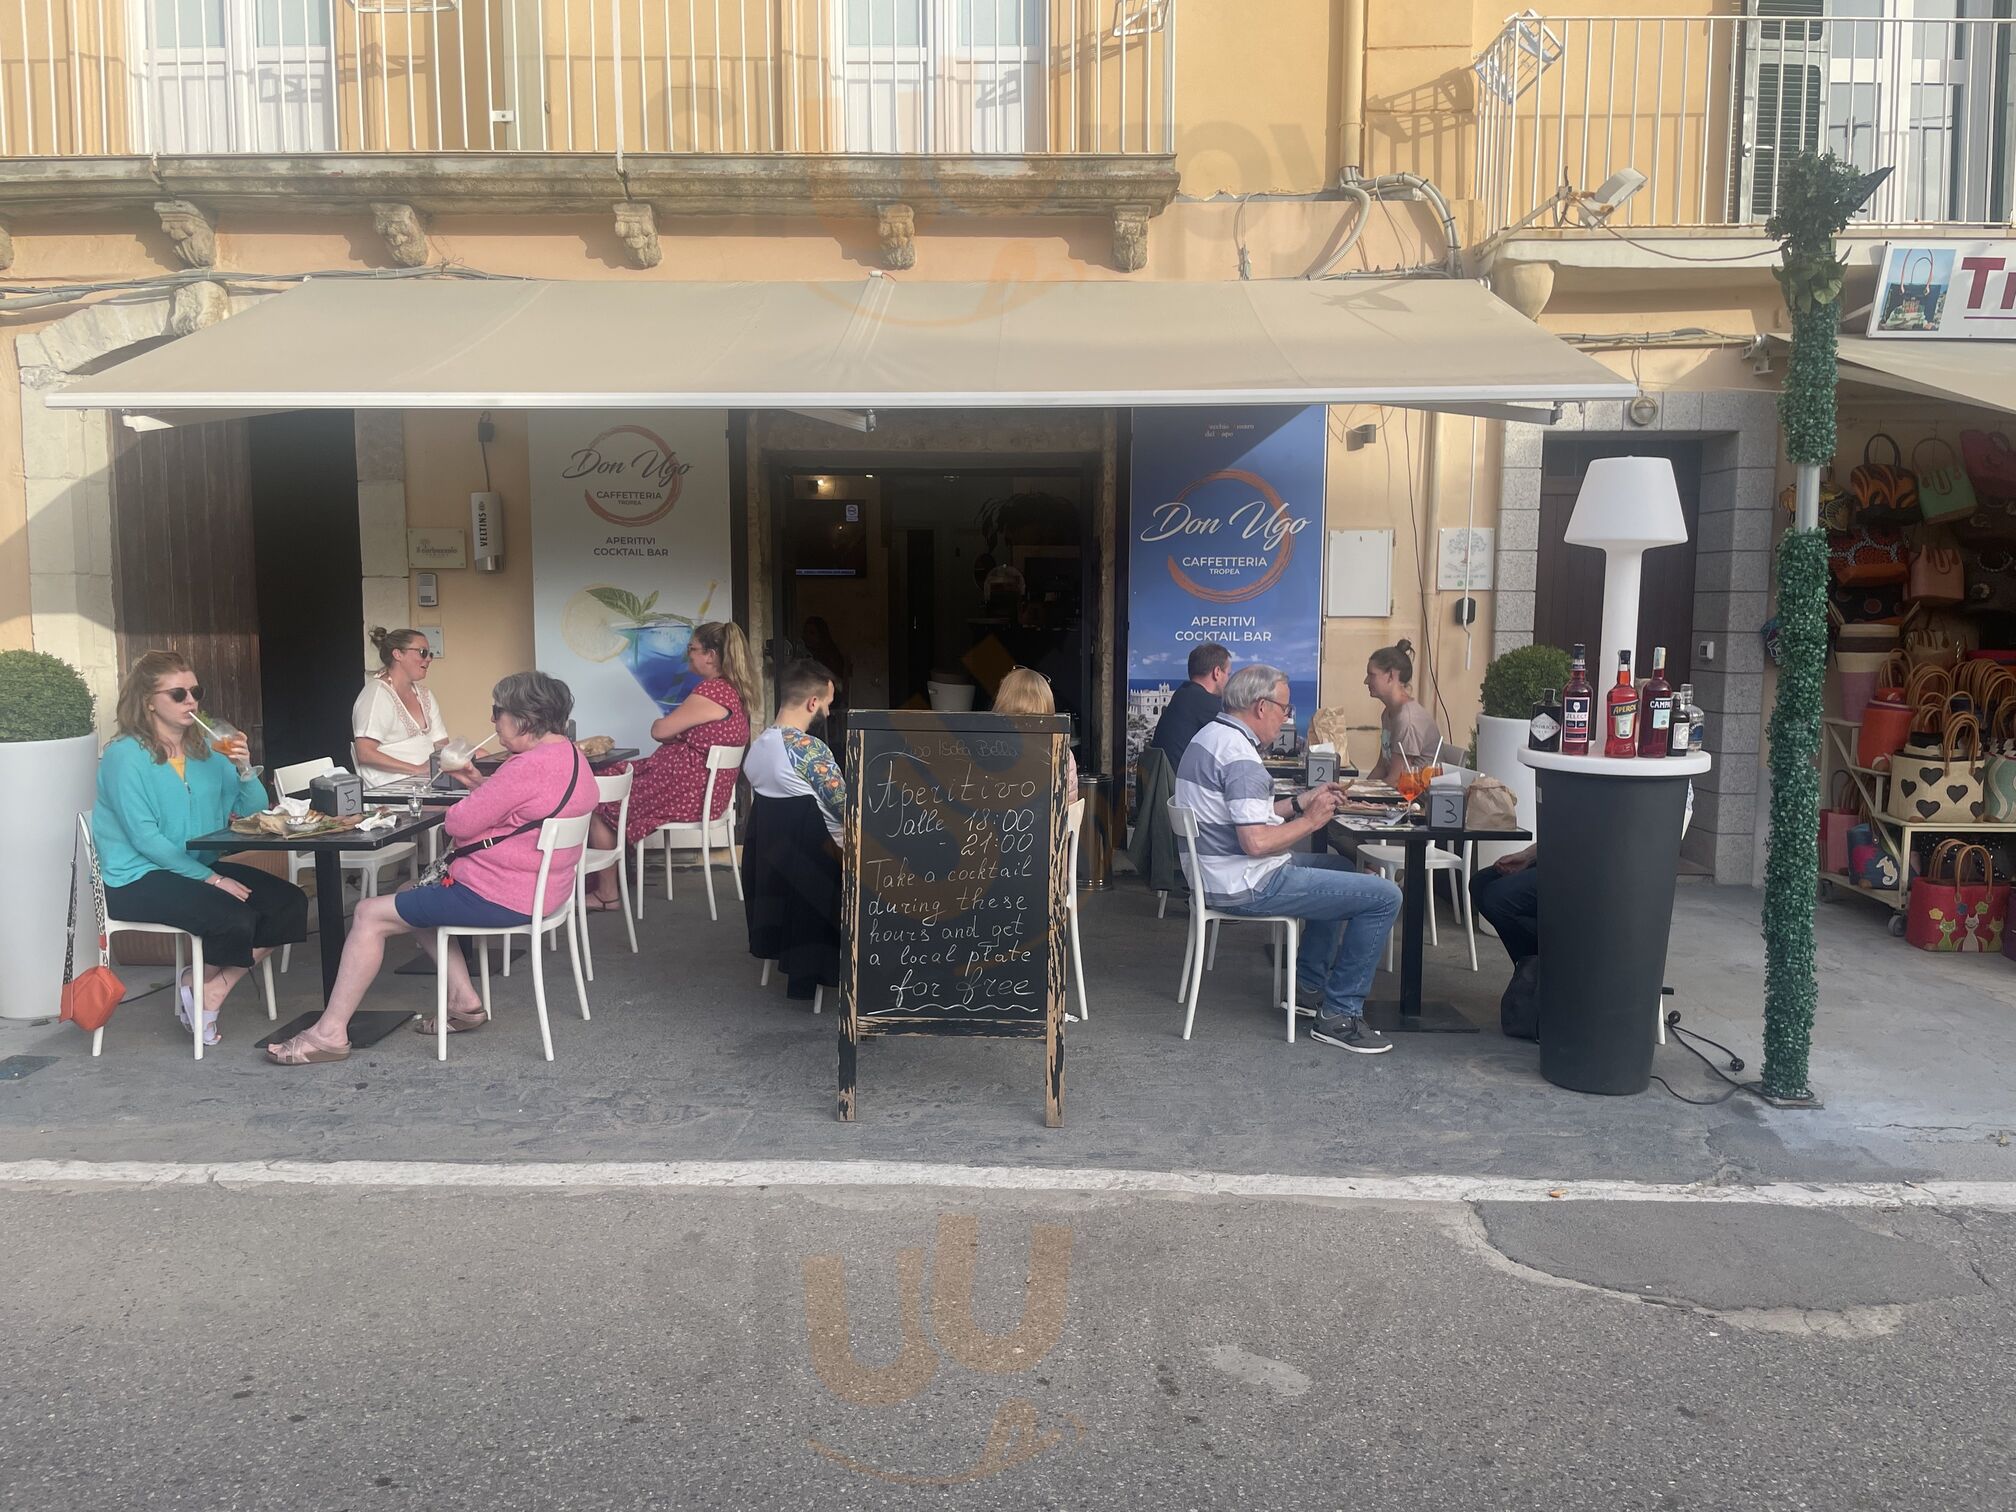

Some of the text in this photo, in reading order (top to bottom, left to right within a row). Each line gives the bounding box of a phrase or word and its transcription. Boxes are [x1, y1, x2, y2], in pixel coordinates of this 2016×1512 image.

[562, 448, 695, 488] Don Ugo
[596, 490, 663, 500] CAFFETTERIA
[478, 512, 488, 547] VELTINS
[1140, 501, 1312, 551] Don Ugo
[593, 547, 669, 557] COCKTAIL BAR
[606, 536, 656, 545] APERITIVI
[1182, 556, 1268, 567] CAFFETTERIA
[1191, 616, 1256, 626] APERITIVI
[1175, 631, 1272, 642] COCKTAIL BAR
[1279, 734, 1287, 746] 1
[1315, 766, 1327, 783] 2
[344, 789, 356, 811] 5
[868, 760, 1036, 837] Aperitivo
[964, 808, 1035, 832] 18:00
[1443, 799, 1457, 824] 3
[960, 832, 1034, 856] 21:00
[866, 854, 1033, 891] Take a cocktail
[868, 887, 1028, 926] during these
[869, 913, 1025, 948] hours and get
[869, 940, 1031, 977] a local plate
[889, 966, 1035, 1008] for free
